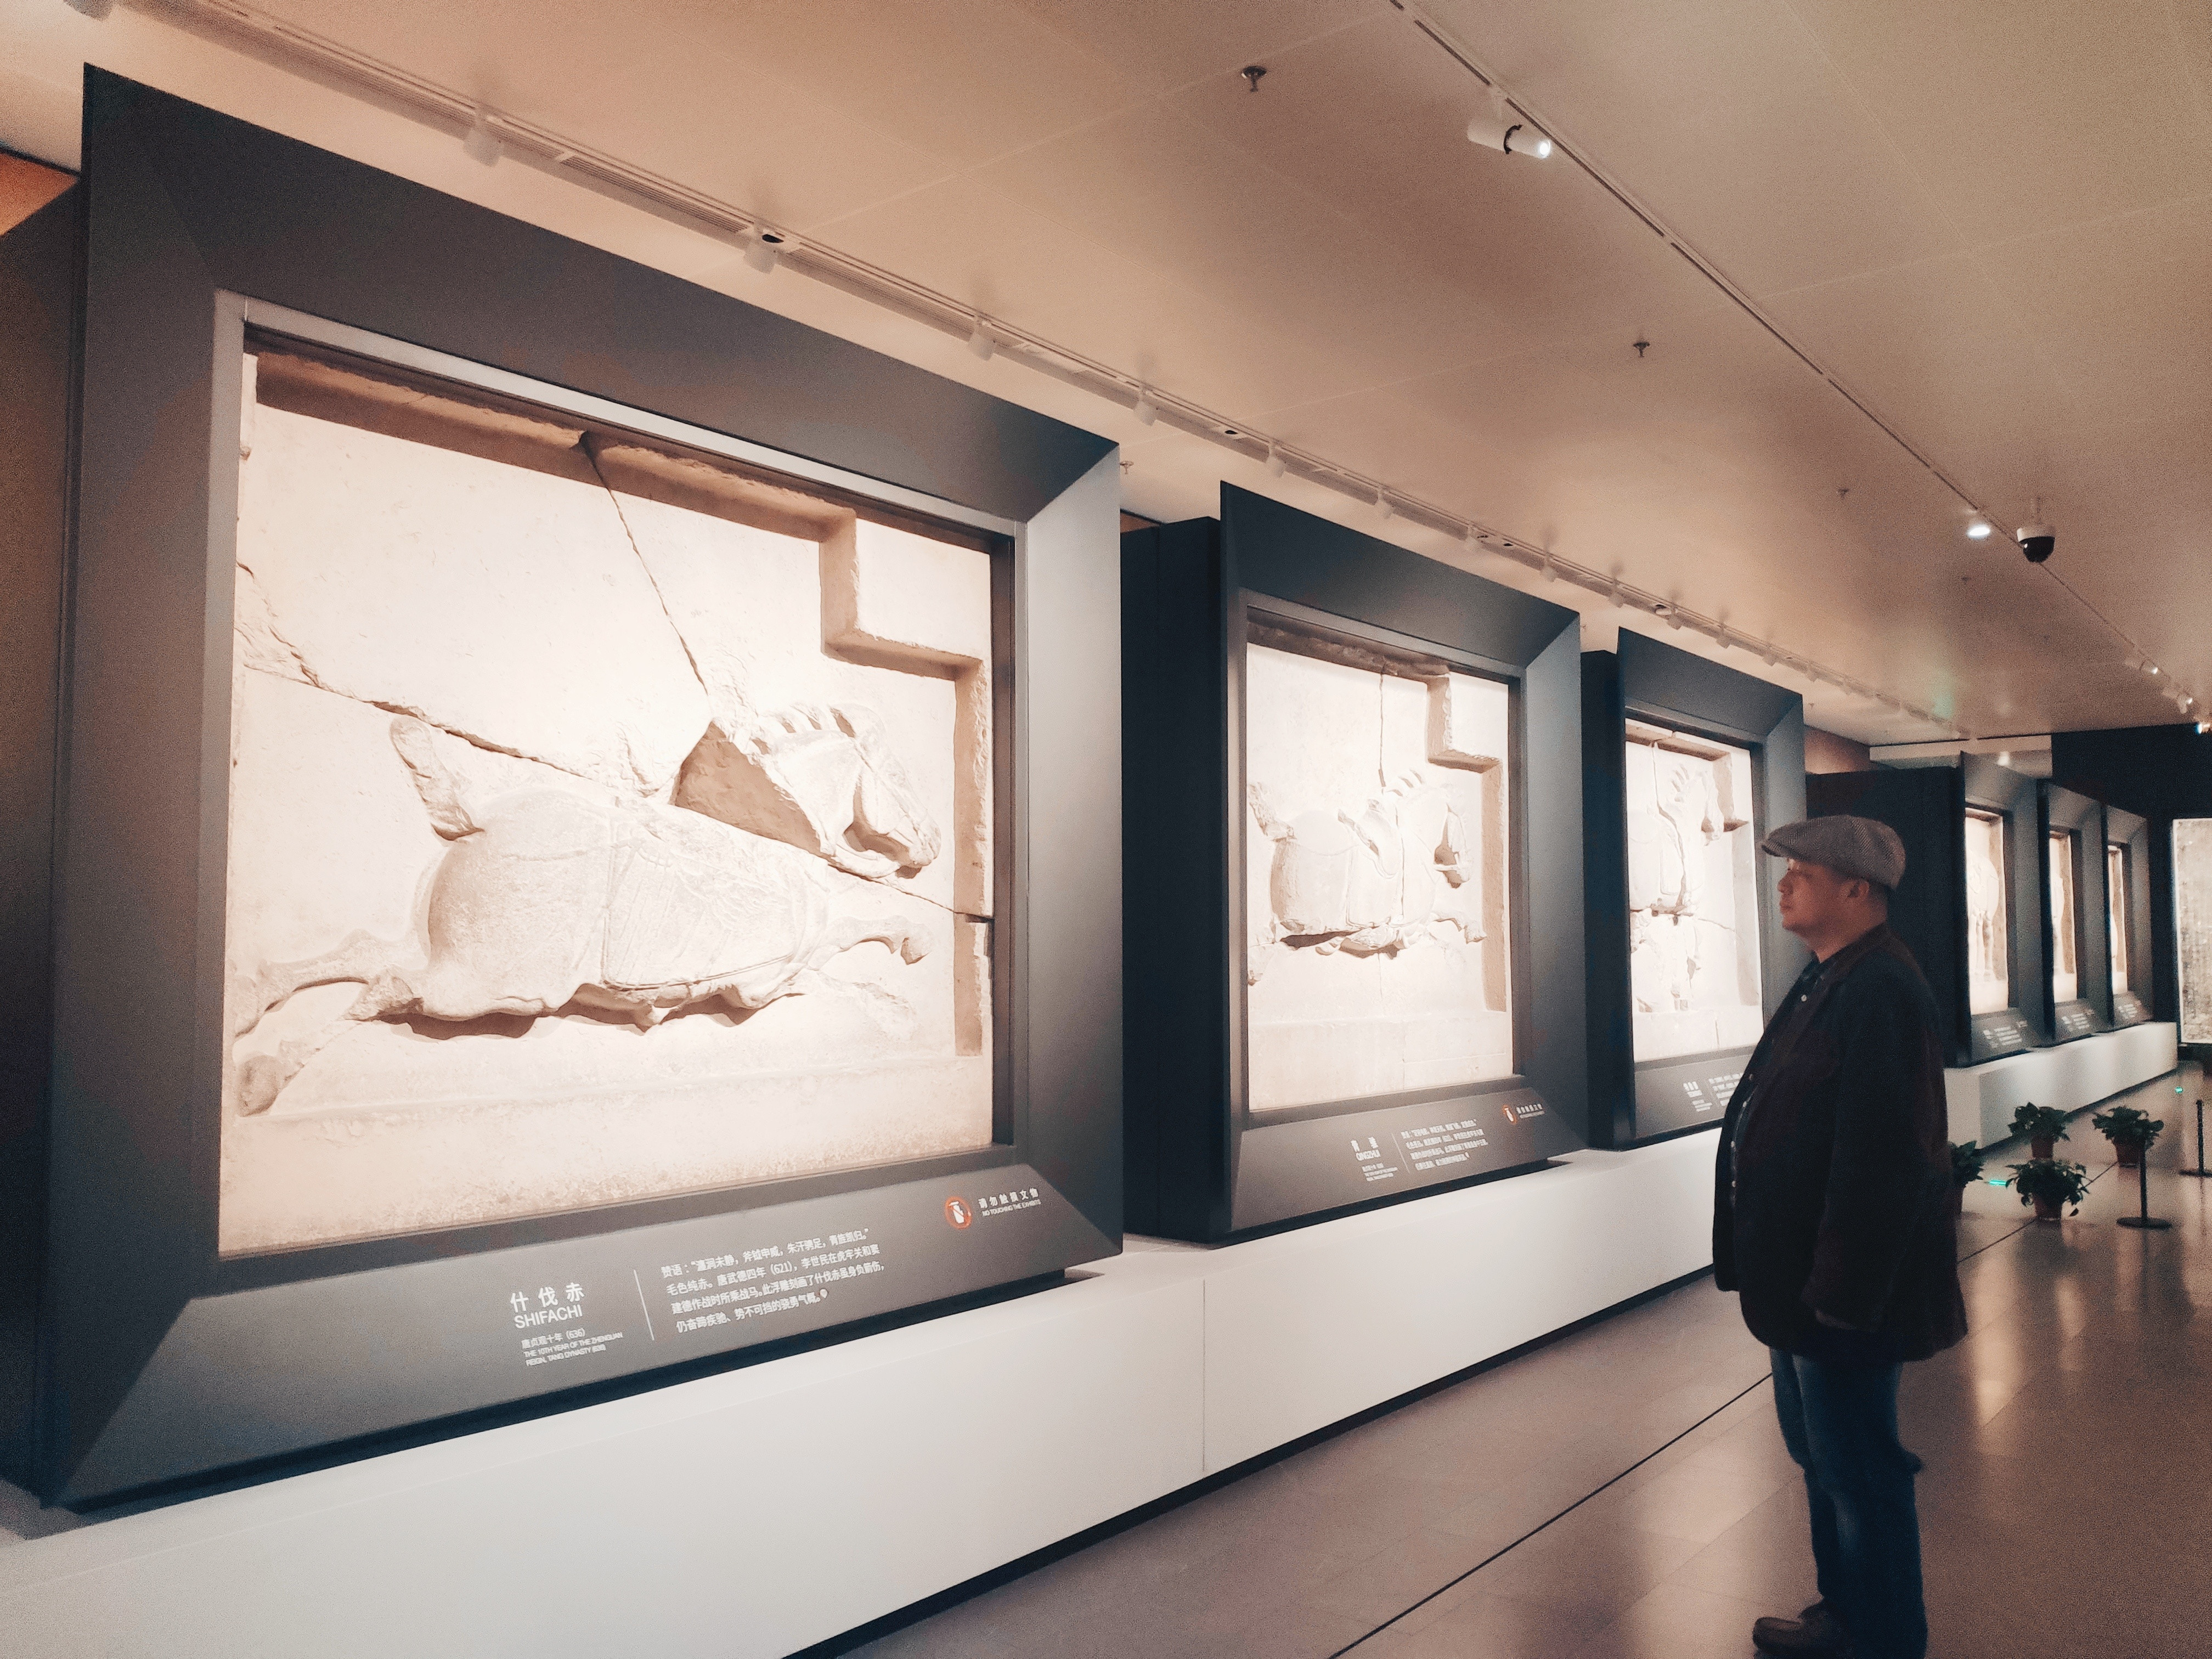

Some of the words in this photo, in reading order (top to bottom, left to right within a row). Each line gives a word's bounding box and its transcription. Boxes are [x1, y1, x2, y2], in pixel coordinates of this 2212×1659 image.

[510, 1282, 585, 1313] 什伐赤
[514, 1304, 583, 1329] SHIFACHI
[523, 1350, 537, 1358] THE
[538, 1347, 553, 1355] 10TH
[553, 1343, 569, 1351] YEAR
[547, 1353, 565, 1362] TANG
[564, 1347, 591, 1358] DYNASTY
